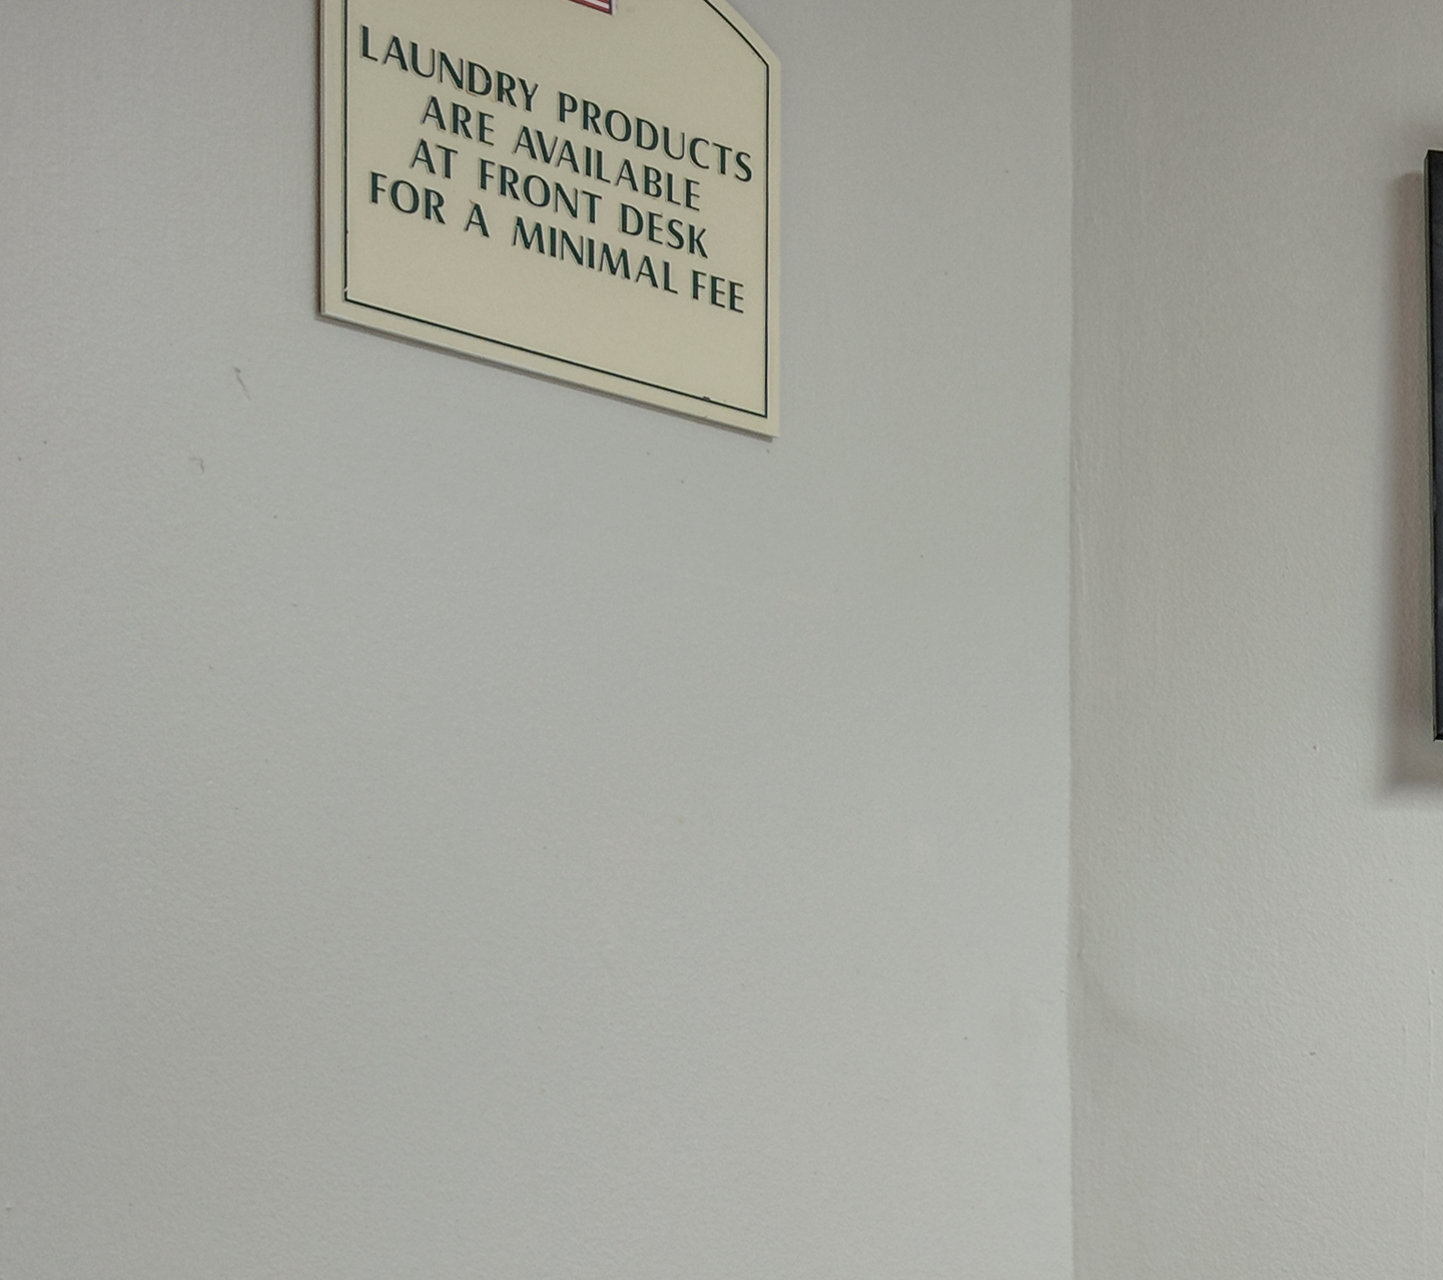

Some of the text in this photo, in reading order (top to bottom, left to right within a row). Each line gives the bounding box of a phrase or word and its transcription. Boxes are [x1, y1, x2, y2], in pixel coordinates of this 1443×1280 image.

[360, 24, 754, 183] LAUNDRY PRODUCTS
[422, 95, 700, 211] ARE AVAILABLE
[369, 171, 745, 314] FOR A MINIMAL FEE
[411, 138, 709, 259] AT FRONT DESK
